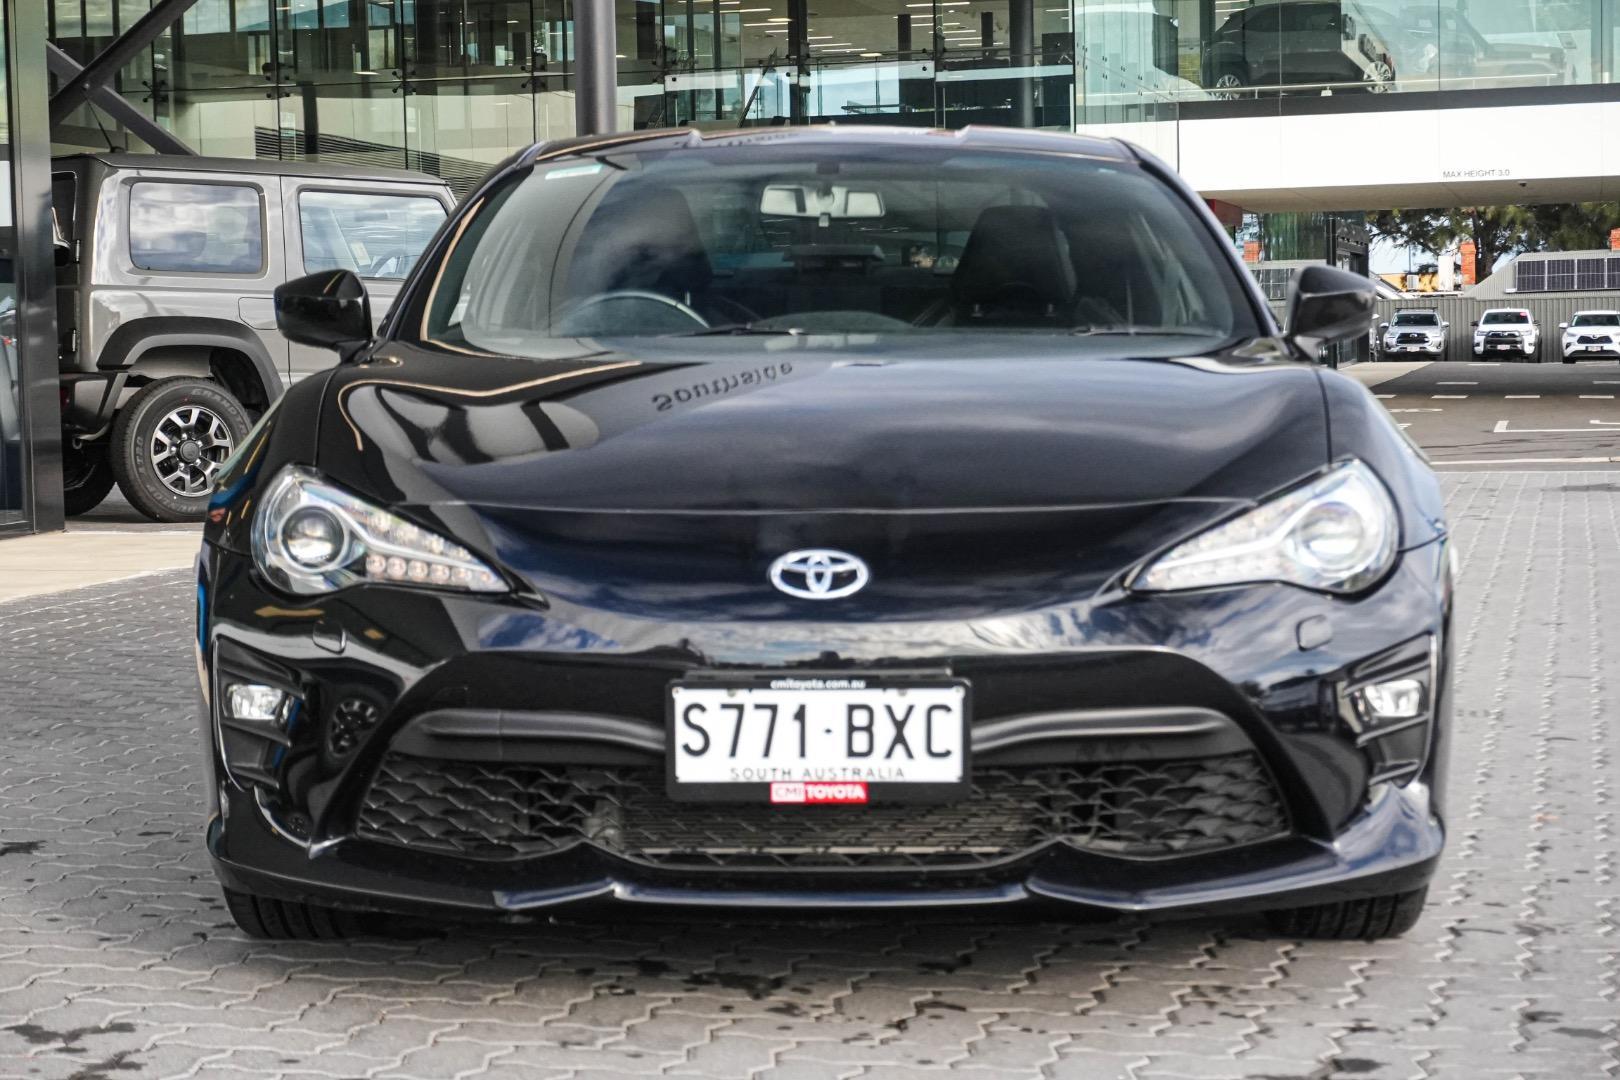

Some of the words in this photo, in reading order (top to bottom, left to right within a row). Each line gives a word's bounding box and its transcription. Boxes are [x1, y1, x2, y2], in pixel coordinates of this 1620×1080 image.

[1442, 170, 1461, 178] MAX
[1464, 169, 1495, 177] HEIGHT
[1498, 168, 1511, 176] 3.0
[191, 388, 248, 434] GRANDTR
[770, 679, 866, 689] cmitoyota.com.au
[730, 767, 792, 780] SOUTH
[803, 767, 905, 780] AUSTRALIA
[774, 785, 803, 799] CMI
[805, 784, 866, 800] TOYOTA
